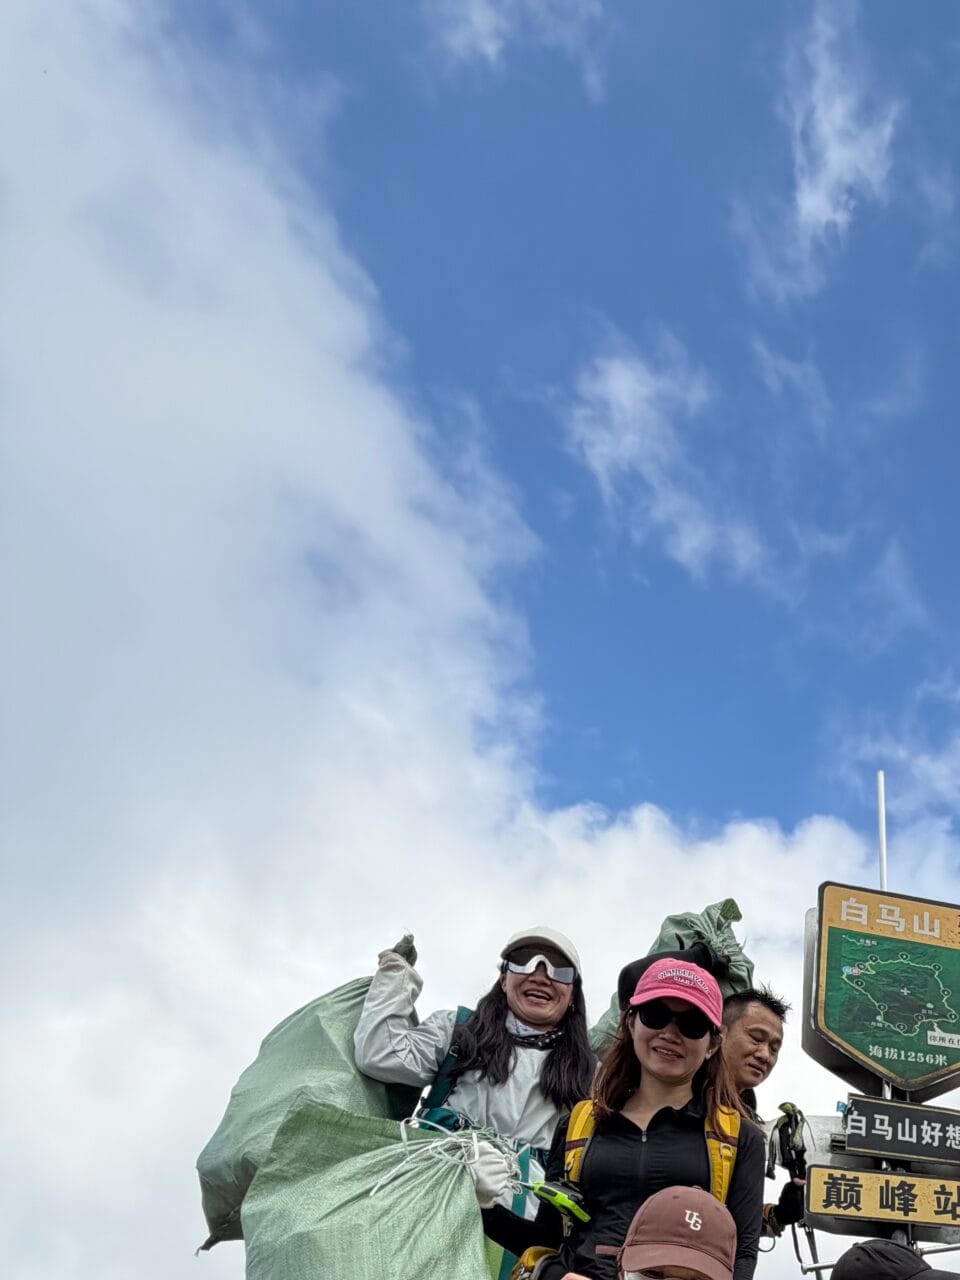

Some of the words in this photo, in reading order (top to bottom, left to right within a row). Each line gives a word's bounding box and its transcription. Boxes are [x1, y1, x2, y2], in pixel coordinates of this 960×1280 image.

[841, 898, 940, 938] 白马山
[868, 1044, 948, 1066] 海拔1256米
